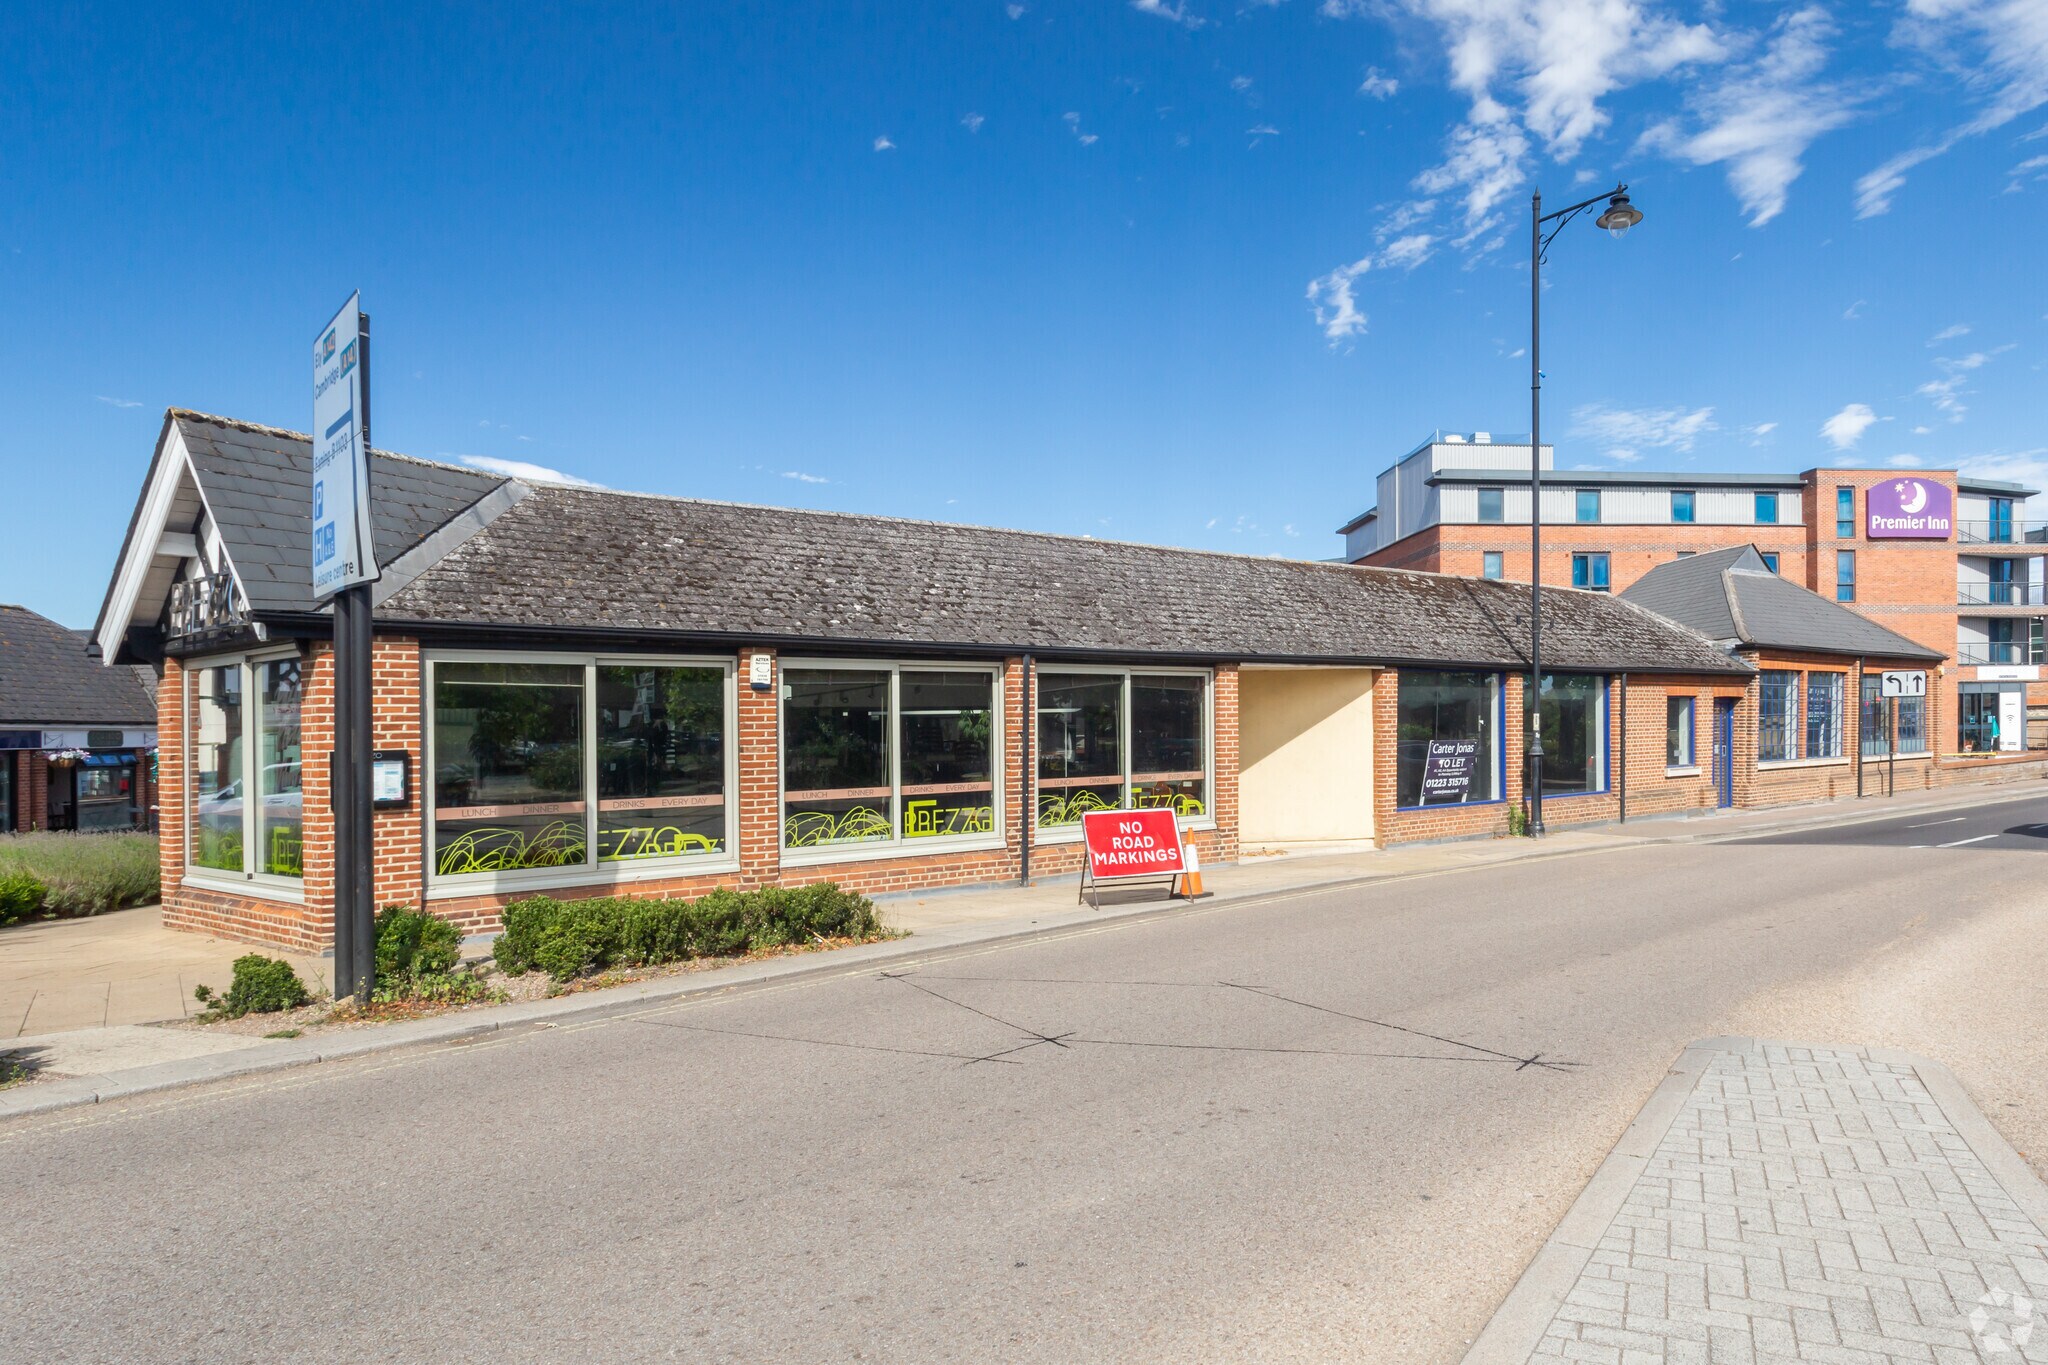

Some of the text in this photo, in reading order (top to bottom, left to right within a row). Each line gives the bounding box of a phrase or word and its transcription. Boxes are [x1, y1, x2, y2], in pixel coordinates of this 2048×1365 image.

[1872, 515, 1949, 530] Premier Inn
[333, 559, 354, 580] centre
[1432, 742, 1475, 756] Carter Jonas
[1439, 758, 1466, 768] TO LET
[1425, 777, 1469, 788] 01223 315716
[802, 783, 980, 799] LUNCH DINNER DRINKS EVERY DAY
[461, 796, 708, 818] LUNCH DINNER DRINKS EVERY DAY
[1119, 821, 1142, 834] NO
[1112, 835, 1154, 850] ROAD
[1094, 848, 1178, 866] MARKINGS
